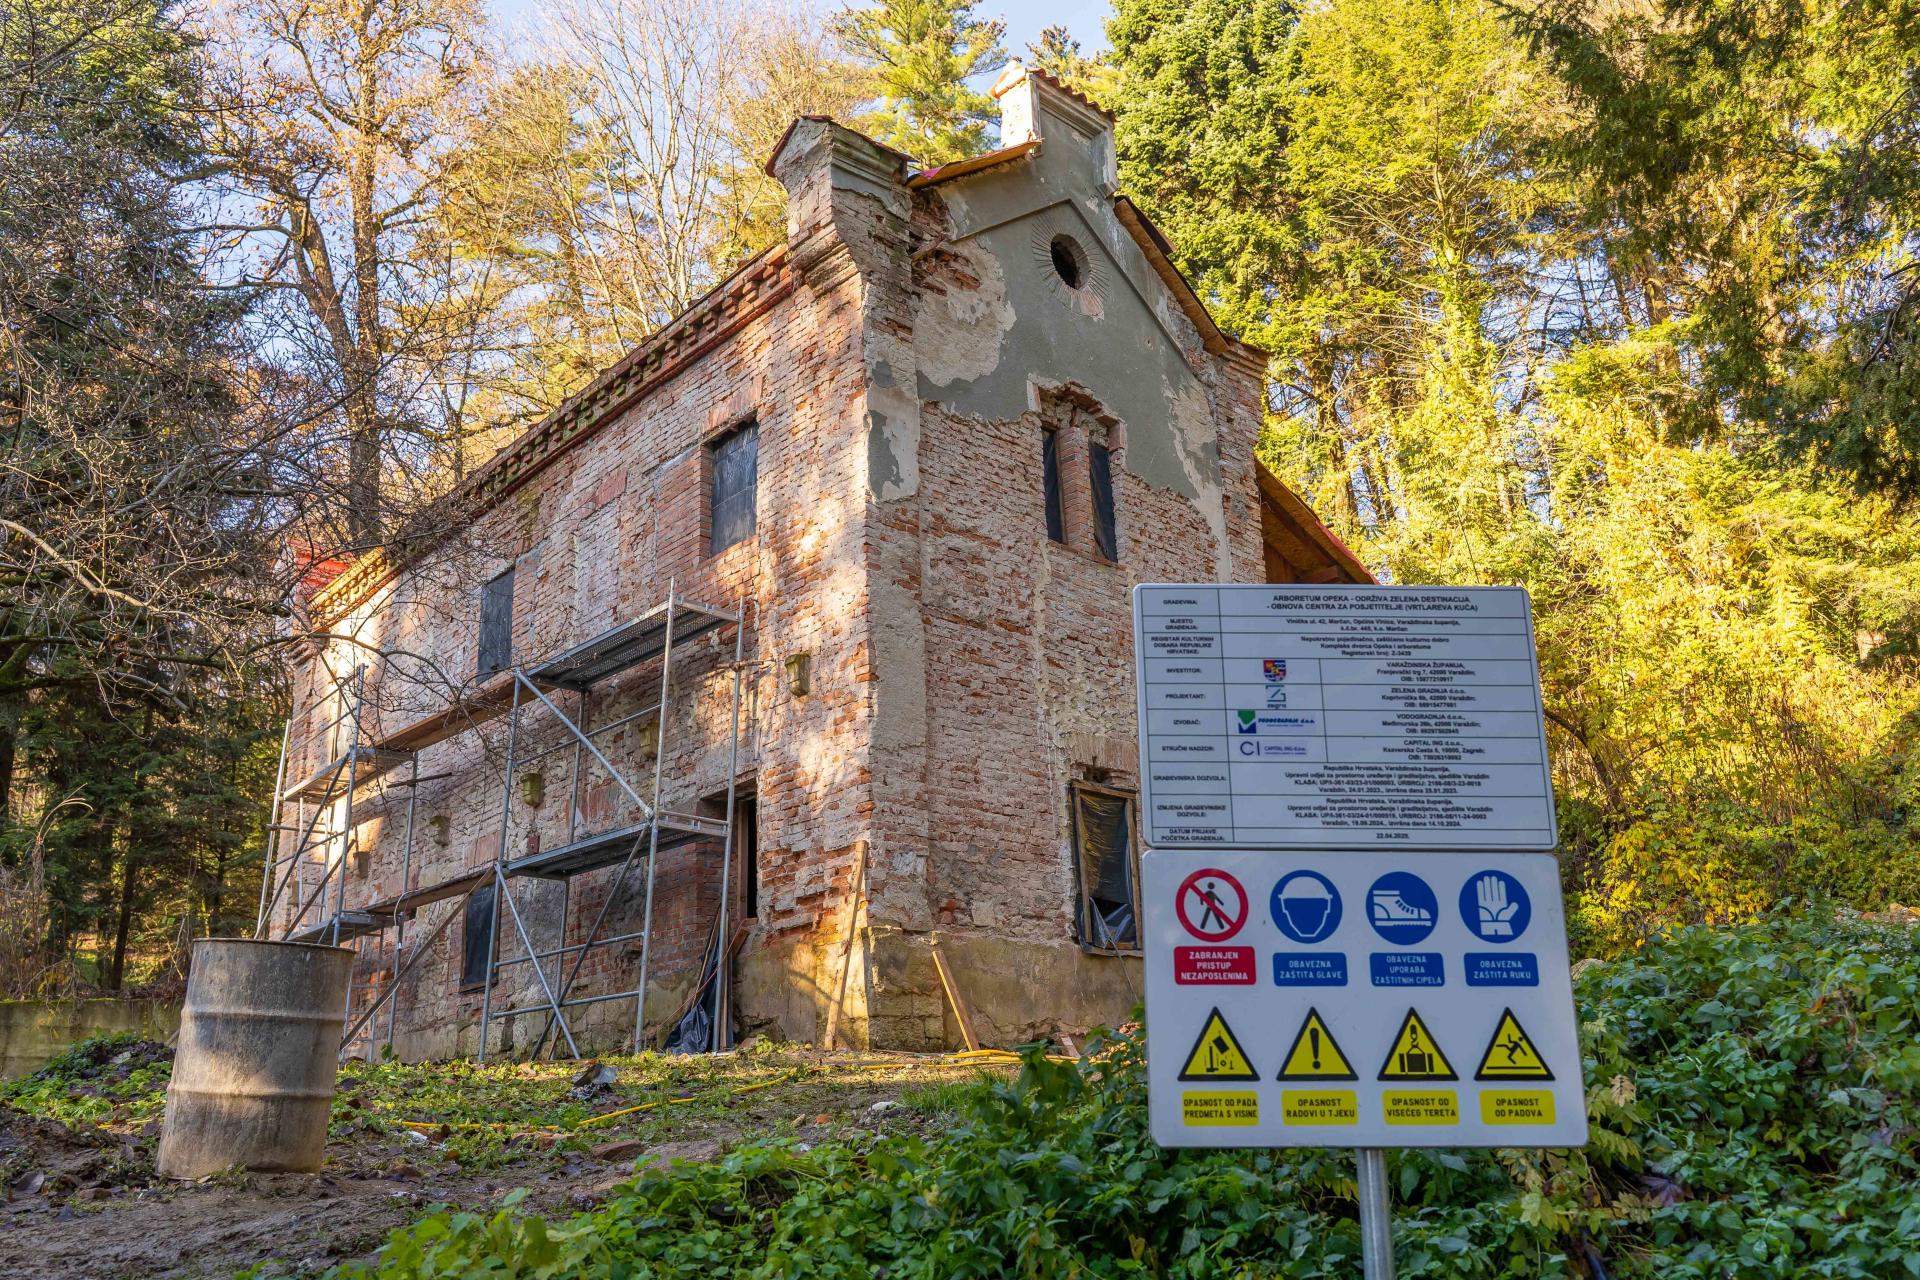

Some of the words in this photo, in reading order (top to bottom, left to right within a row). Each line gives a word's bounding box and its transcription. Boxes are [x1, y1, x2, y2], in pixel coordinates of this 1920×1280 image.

[1386, 955, 1427, 964] OBAVEZNA
[1197, 962, 1232, 970] PRISTUP
[1289, 960, 1331, 968] OBAVEZNA
[1480, 960, 1522, 968] OBAVEZNA
[1181, 972, 1248, 980] NEZAPOSLENIMA
[1280, 971, 1314, 979] ZAŠTITA
[1317, 971, 1342, 979] GLAVE
[1474, 971, 1508, 979] ZAŠTITA
[1510, 971, 1531, 979] RUKU
[1375, 976, 1414, 984] ZAŠTITNIH
[1416, 976, 1442, 984] CIPELA
[1184, 1098, 1222, 1107] OPASNOST
[1225, 1098, 1235, 1107] OD
[1236, 1098, 1257, 1107] PADA
[1298, 1098, 1341, 1107] OPASNOST
[1392, 1098, 1435, 1106] OPASNOST
[1438, 1098, 1449, 1106] OD
[1496, 1098, 1539, 1106] OPASNOST
[1185, 1110, 1224, 1118] PREDMETA
[1226, 1110, 1231, 1118] S
[1234, 1110, 1257, 1118] VISINE
[1286, 1109, 1317, 1118] RADOVI
[1320, 1109, 1325, 1118] U
[1424, 1108, 1456, 1117] TERETA
[1495, 1109, 1505, 1117] OD
[1508, 1109, 1543, 1117] PADOVA
